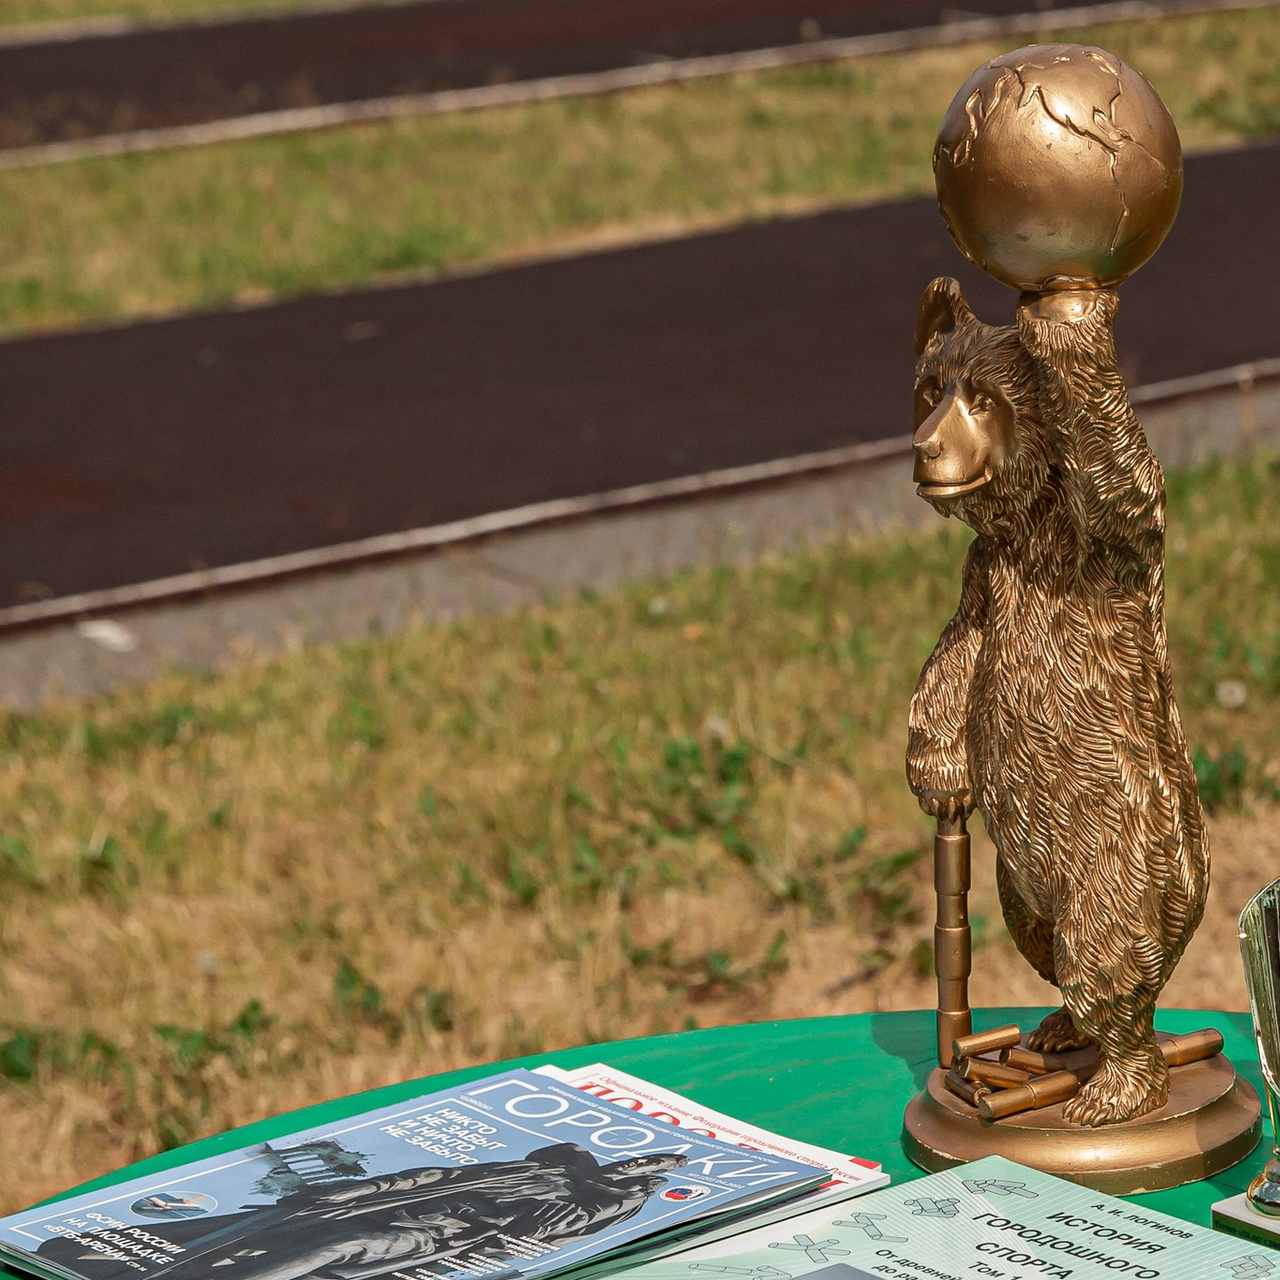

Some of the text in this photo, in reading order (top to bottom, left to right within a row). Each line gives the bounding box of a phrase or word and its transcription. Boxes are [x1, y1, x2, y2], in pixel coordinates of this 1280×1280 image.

[398, 1119, 476, 1152] И НИЧТО
[416, 1113, 507, 1150] НЕ ЗАБЫТ
[435, 1108, 497, 1135] НИКТО
[467, 1079, 799, 1188] ГОРОДКИ
[379, 1124, 479, 1165] НЕ ЗАБЫТО
[85, 1212, 188, 1254] ФСИН РОССИИ
[1046, 1212, 1168, 1255] ИСТОРИЯ
[1091, 1203, 1194, 1240] А. И. ЛОГИНОВ
[43, 1224, 130, 1262] «ВТБ-АРЕНА»
[62, 1217, 175, 1265] НА ПЛОЩАДКЕ
[874, 1249, 896, 1262] От
[971, 1212, 1161, 1280] ГОРОДОШНОГО
[871, 1263, 897, 1276] до
[968, 1261, 1004, 1279] Том
[975, 1241, 1075, 1280] СПОРТА
